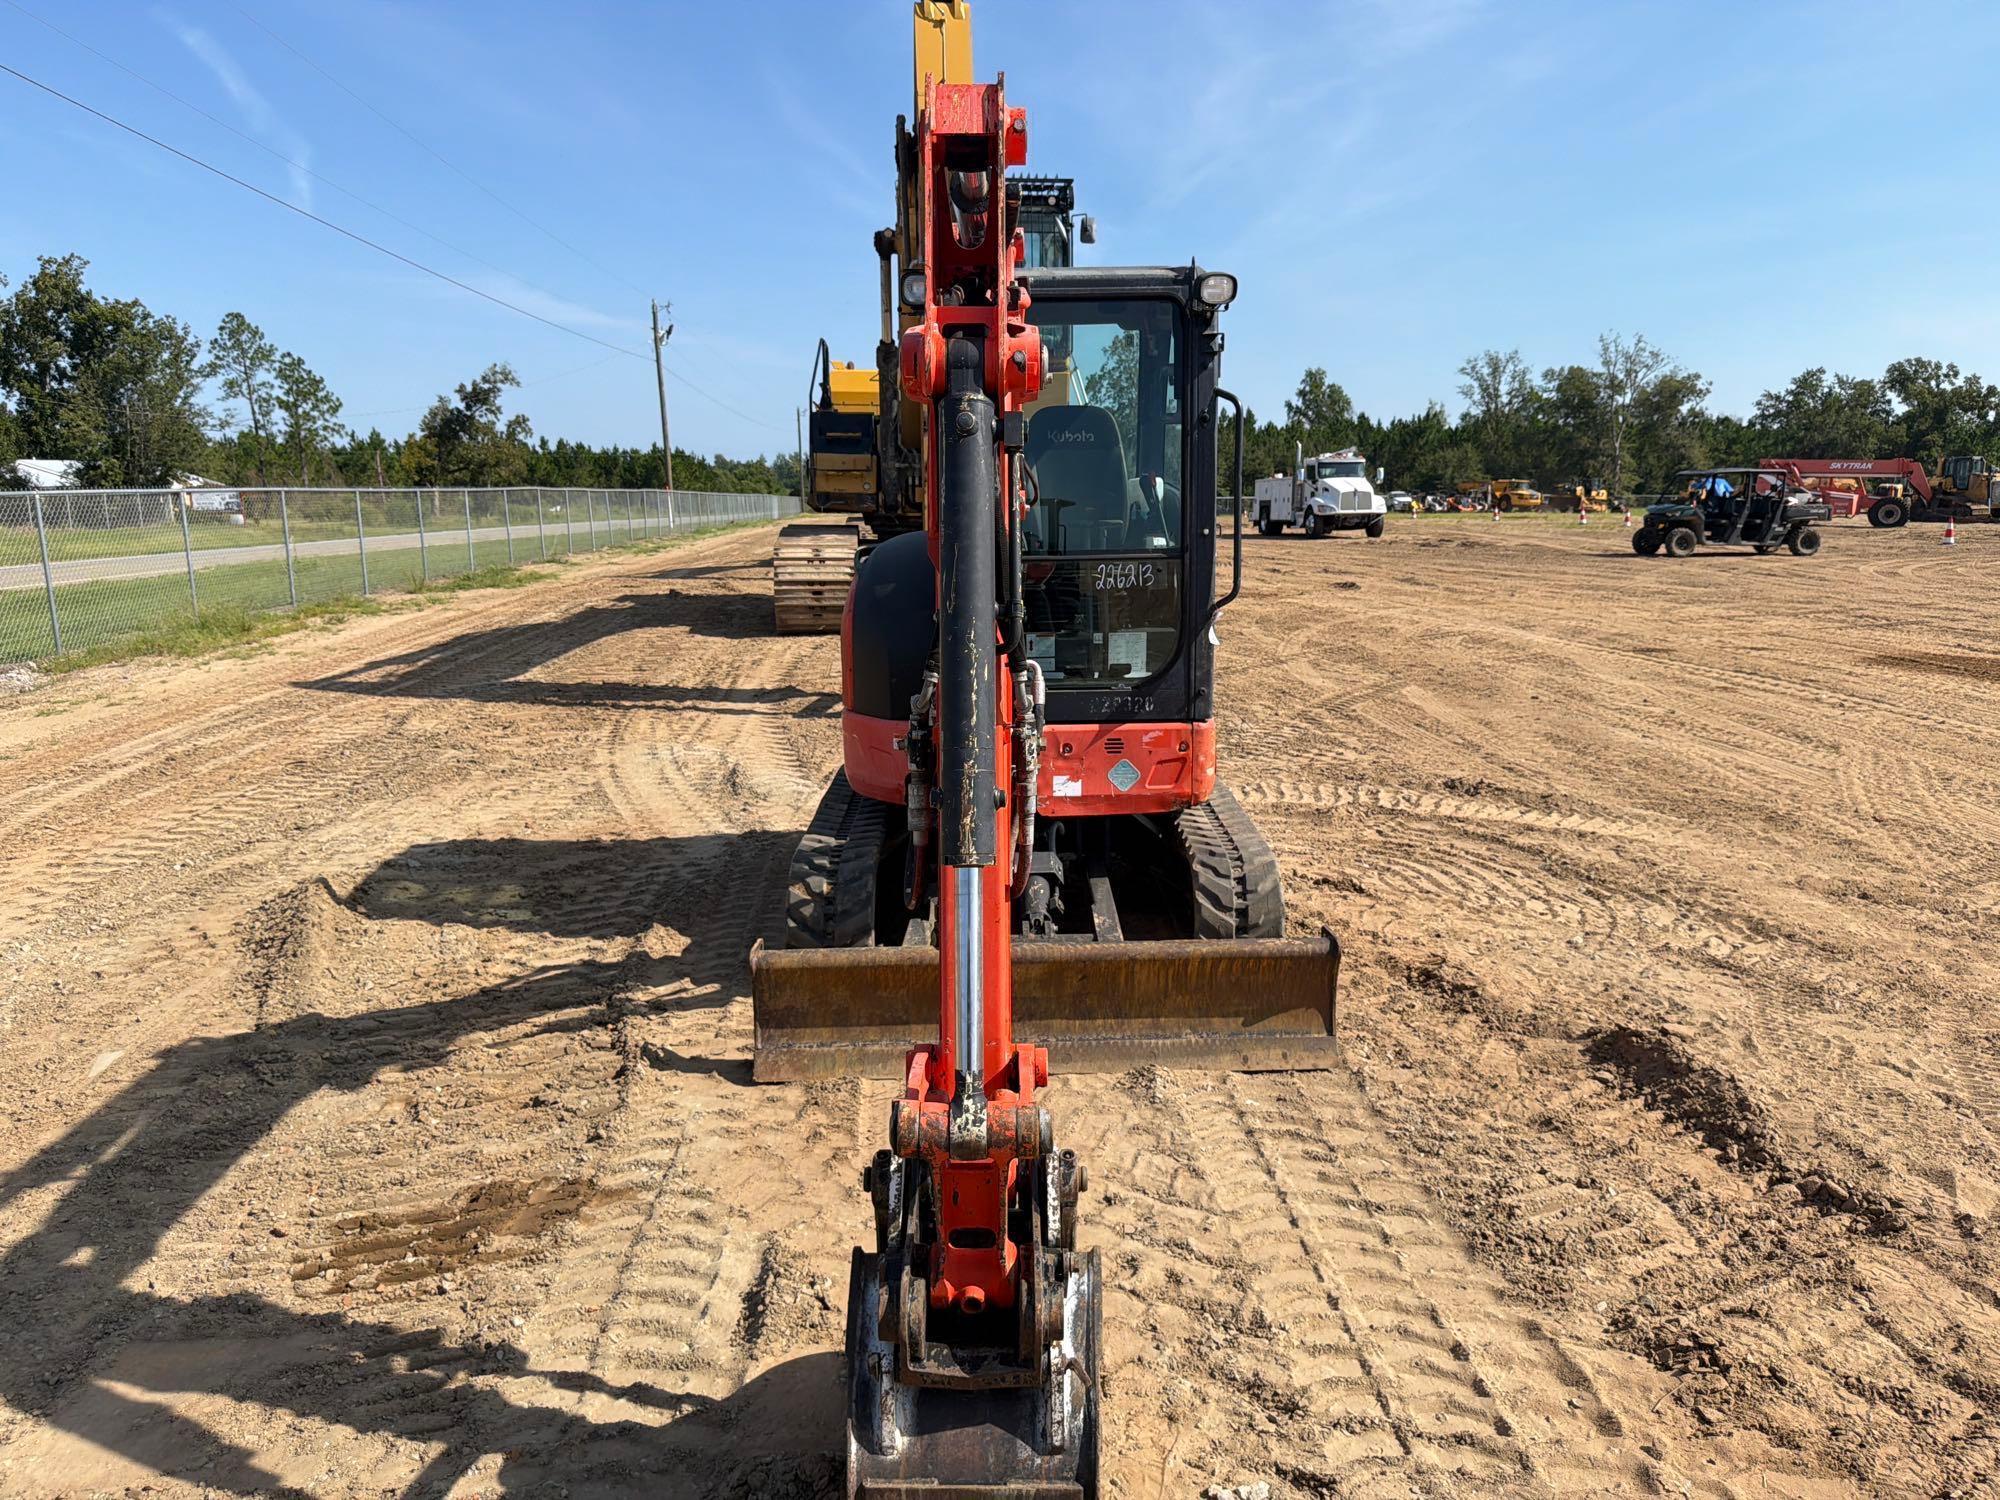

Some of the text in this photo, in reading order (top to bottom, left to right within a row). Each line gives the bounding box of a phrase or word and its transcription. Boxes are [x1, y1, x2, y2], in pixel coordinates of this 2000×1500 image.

[1047, 429, 1095, 442] Kubota
[1829, 462, 1873, 470] SKYTRAK
[1095, 563, 1155, 590] 226213
